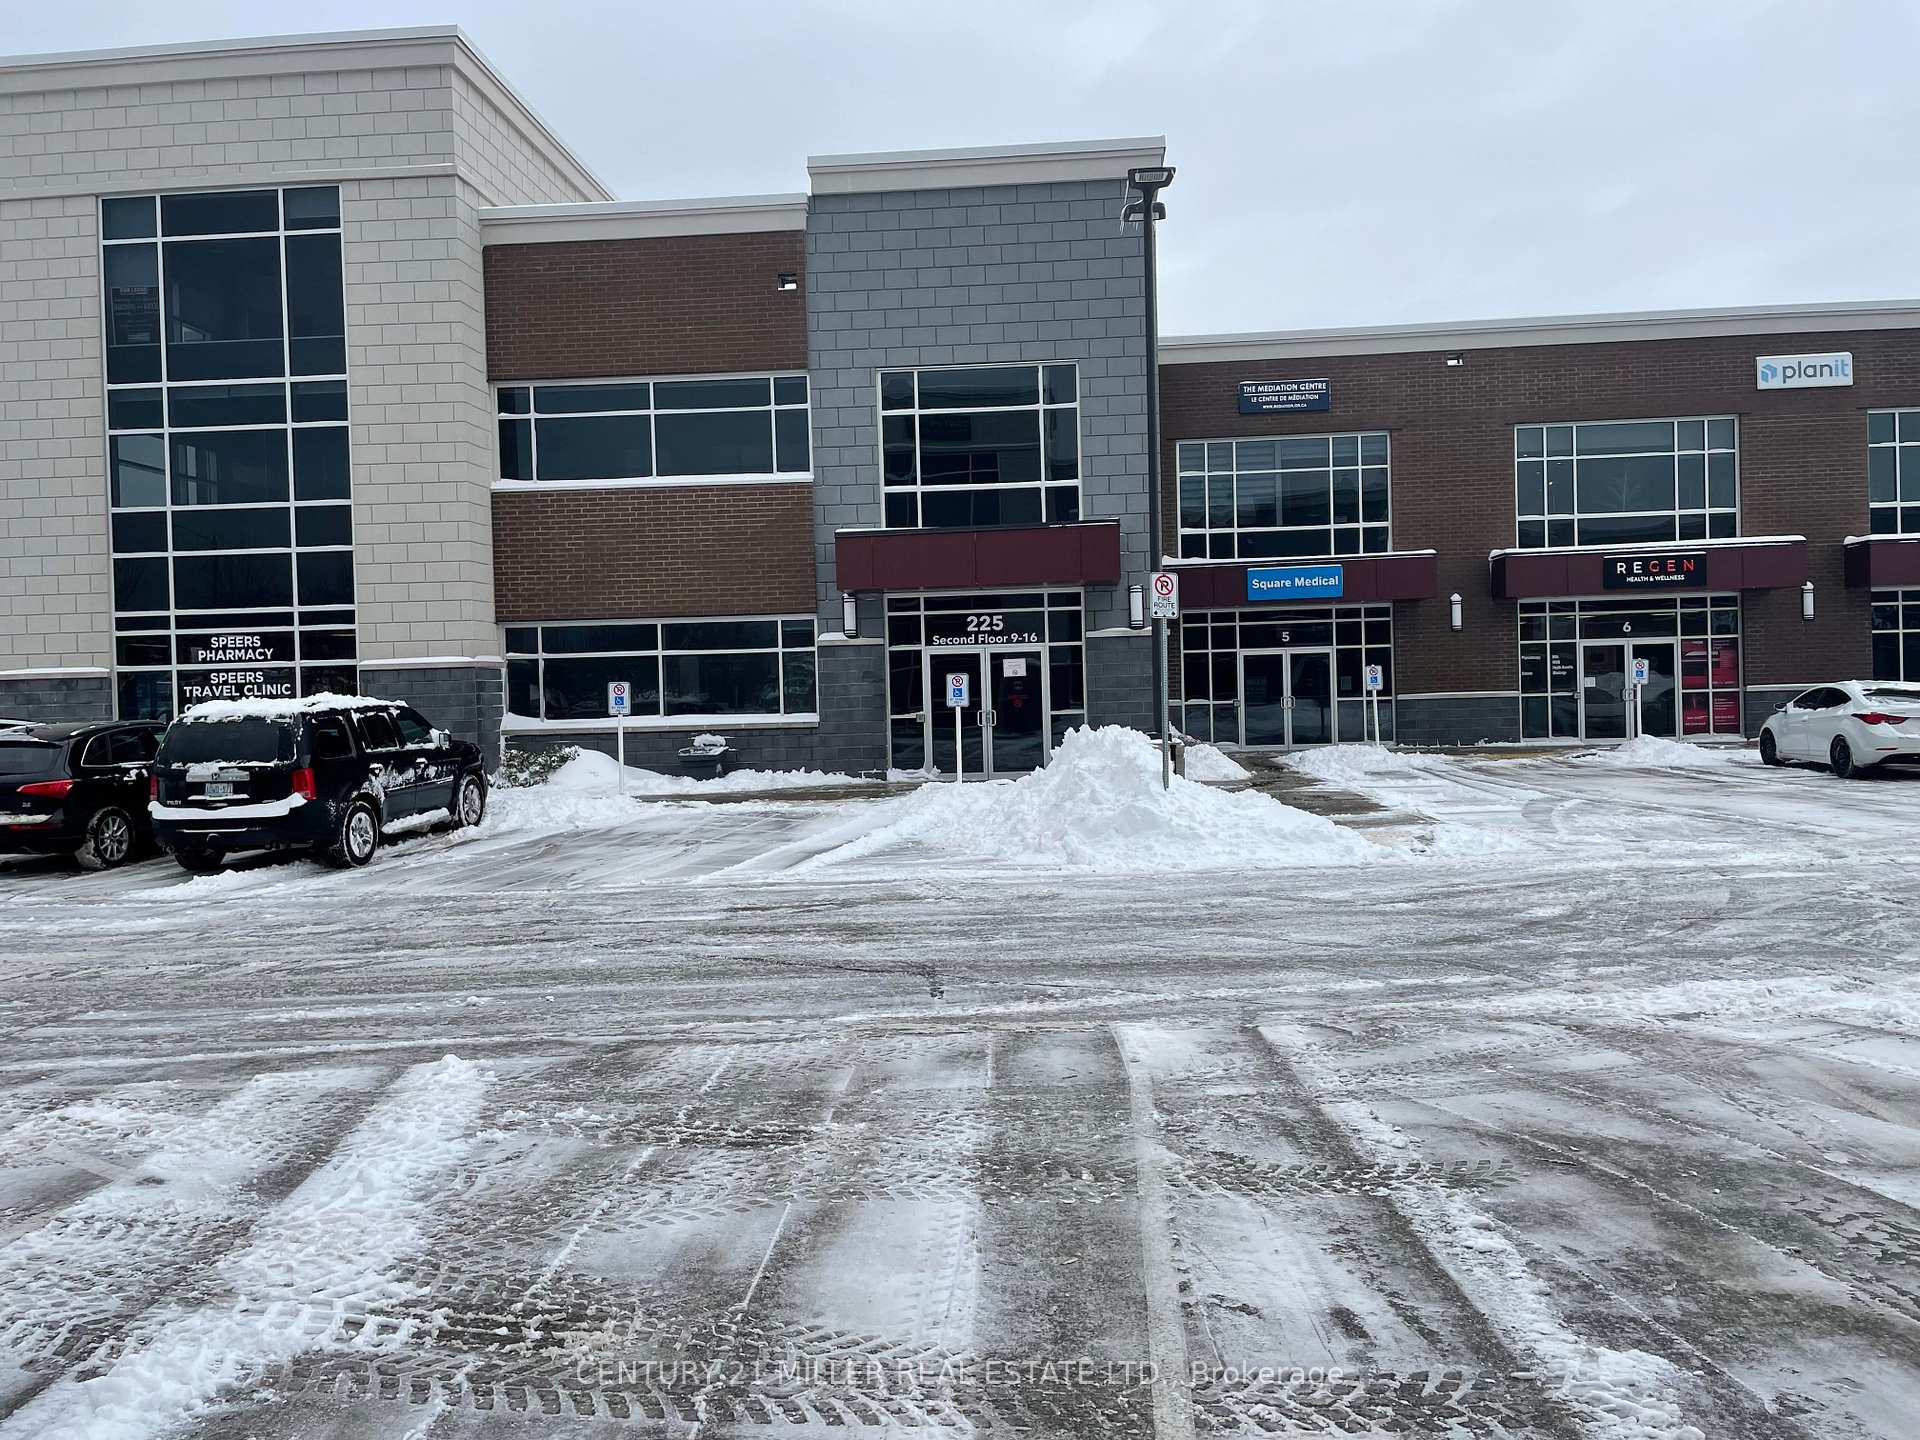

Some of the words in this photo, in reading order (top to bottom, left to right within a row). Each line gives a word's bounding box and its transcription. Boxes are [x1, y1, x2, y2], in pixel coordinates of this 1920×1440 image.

[1782, 359, 1849, 384] planit
[1243, 385, 1256, 393] THE
[1257, 384, 1298, 392] MEDIATION
[1300, 382, 1327, 390] CENTRE
[1616, 559, 1694, 574] REGEN
[1252, 579, 1292, 591] Square
[1294, 575, 1339, 587] Medical
[1153, 601, 1176, 609] ROUTE
[966, 615, 1004, 632] 225
[1622, 621, 1632, 633] 6
[210, 635, 261, 649] SPEERS
[932, 633, 975, 645] Second
[978, 633, 1009, 645] Floor
[1010, 632, 1038, 643] 9-16
[1281, 631, 1290, 642] 5
[198, 648, 274, 661] PHARMACY
[210, 671, 264, 684] SPEERS
[183, 685, 240, 698] TRAVEL
[243, 683, 292, 696] CLINIC
